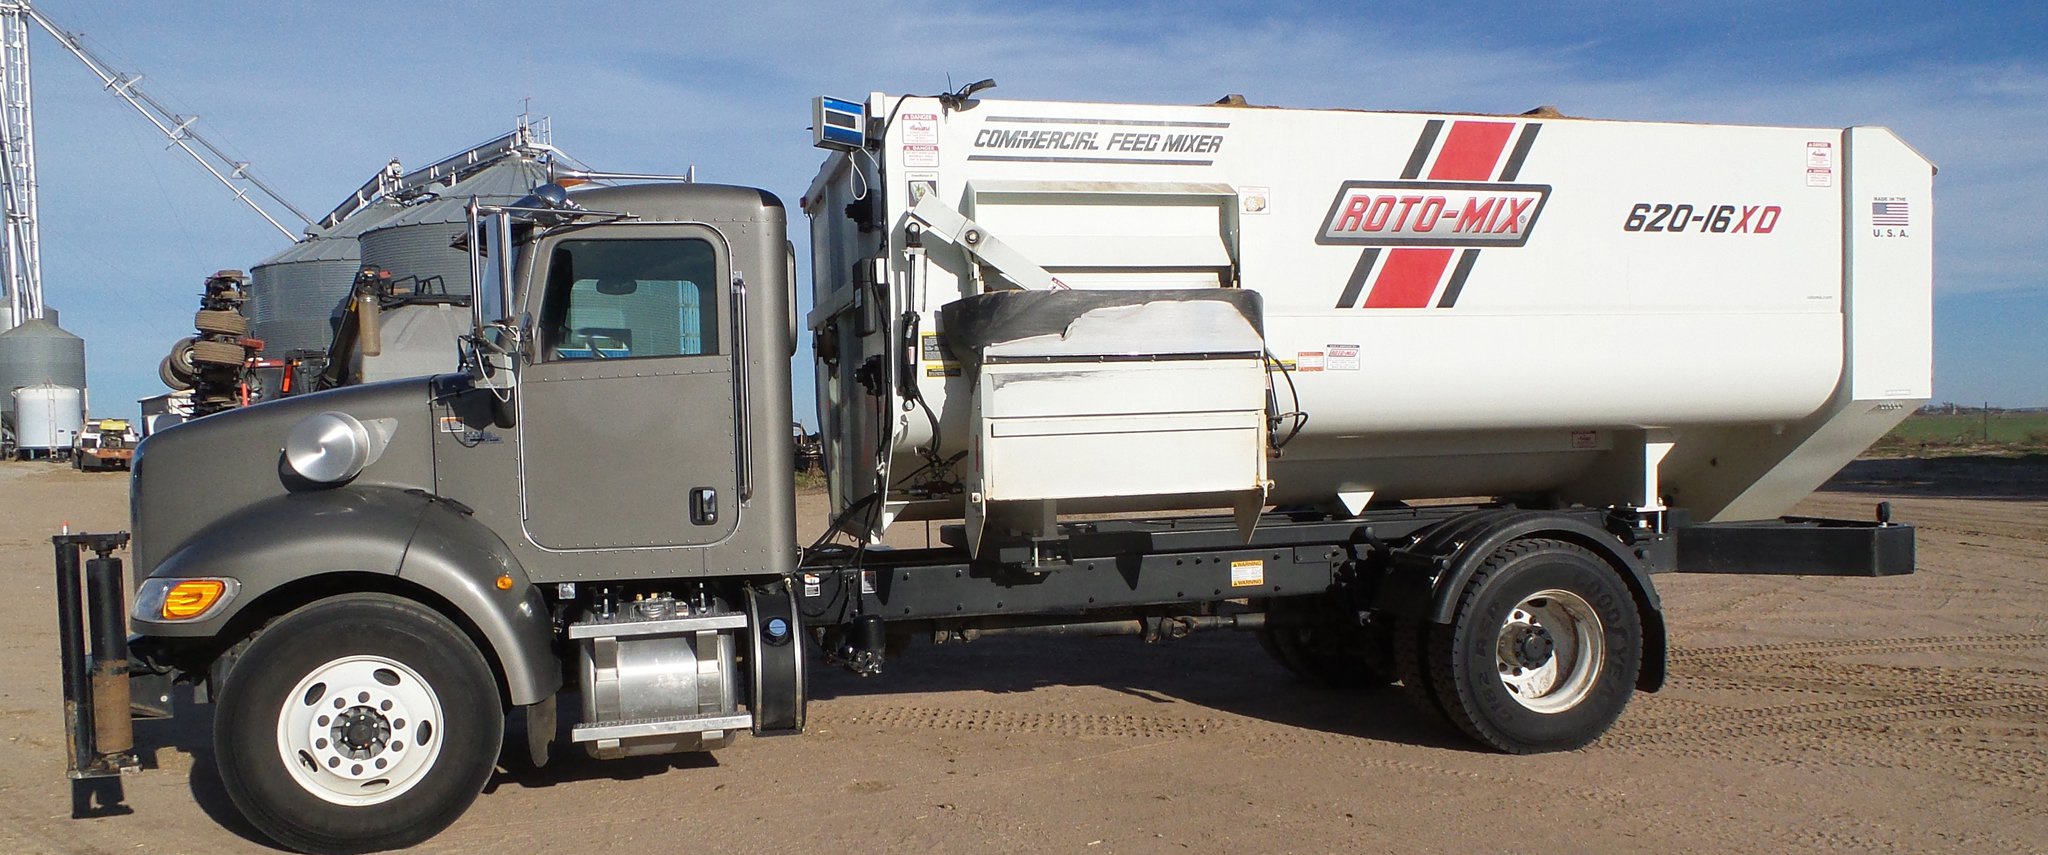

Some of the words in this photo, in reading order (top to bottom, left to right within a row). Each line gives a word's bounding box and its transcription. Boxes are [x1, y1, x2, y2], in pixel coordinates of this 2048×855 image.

[974, 129, 1100, 150] COMMERCIAL
[1106, 132, 1161, 151] FEED
[1161, 133, 1224, 153] MIXER
[1333, 194, 1534, 234] ROTO-MIX
